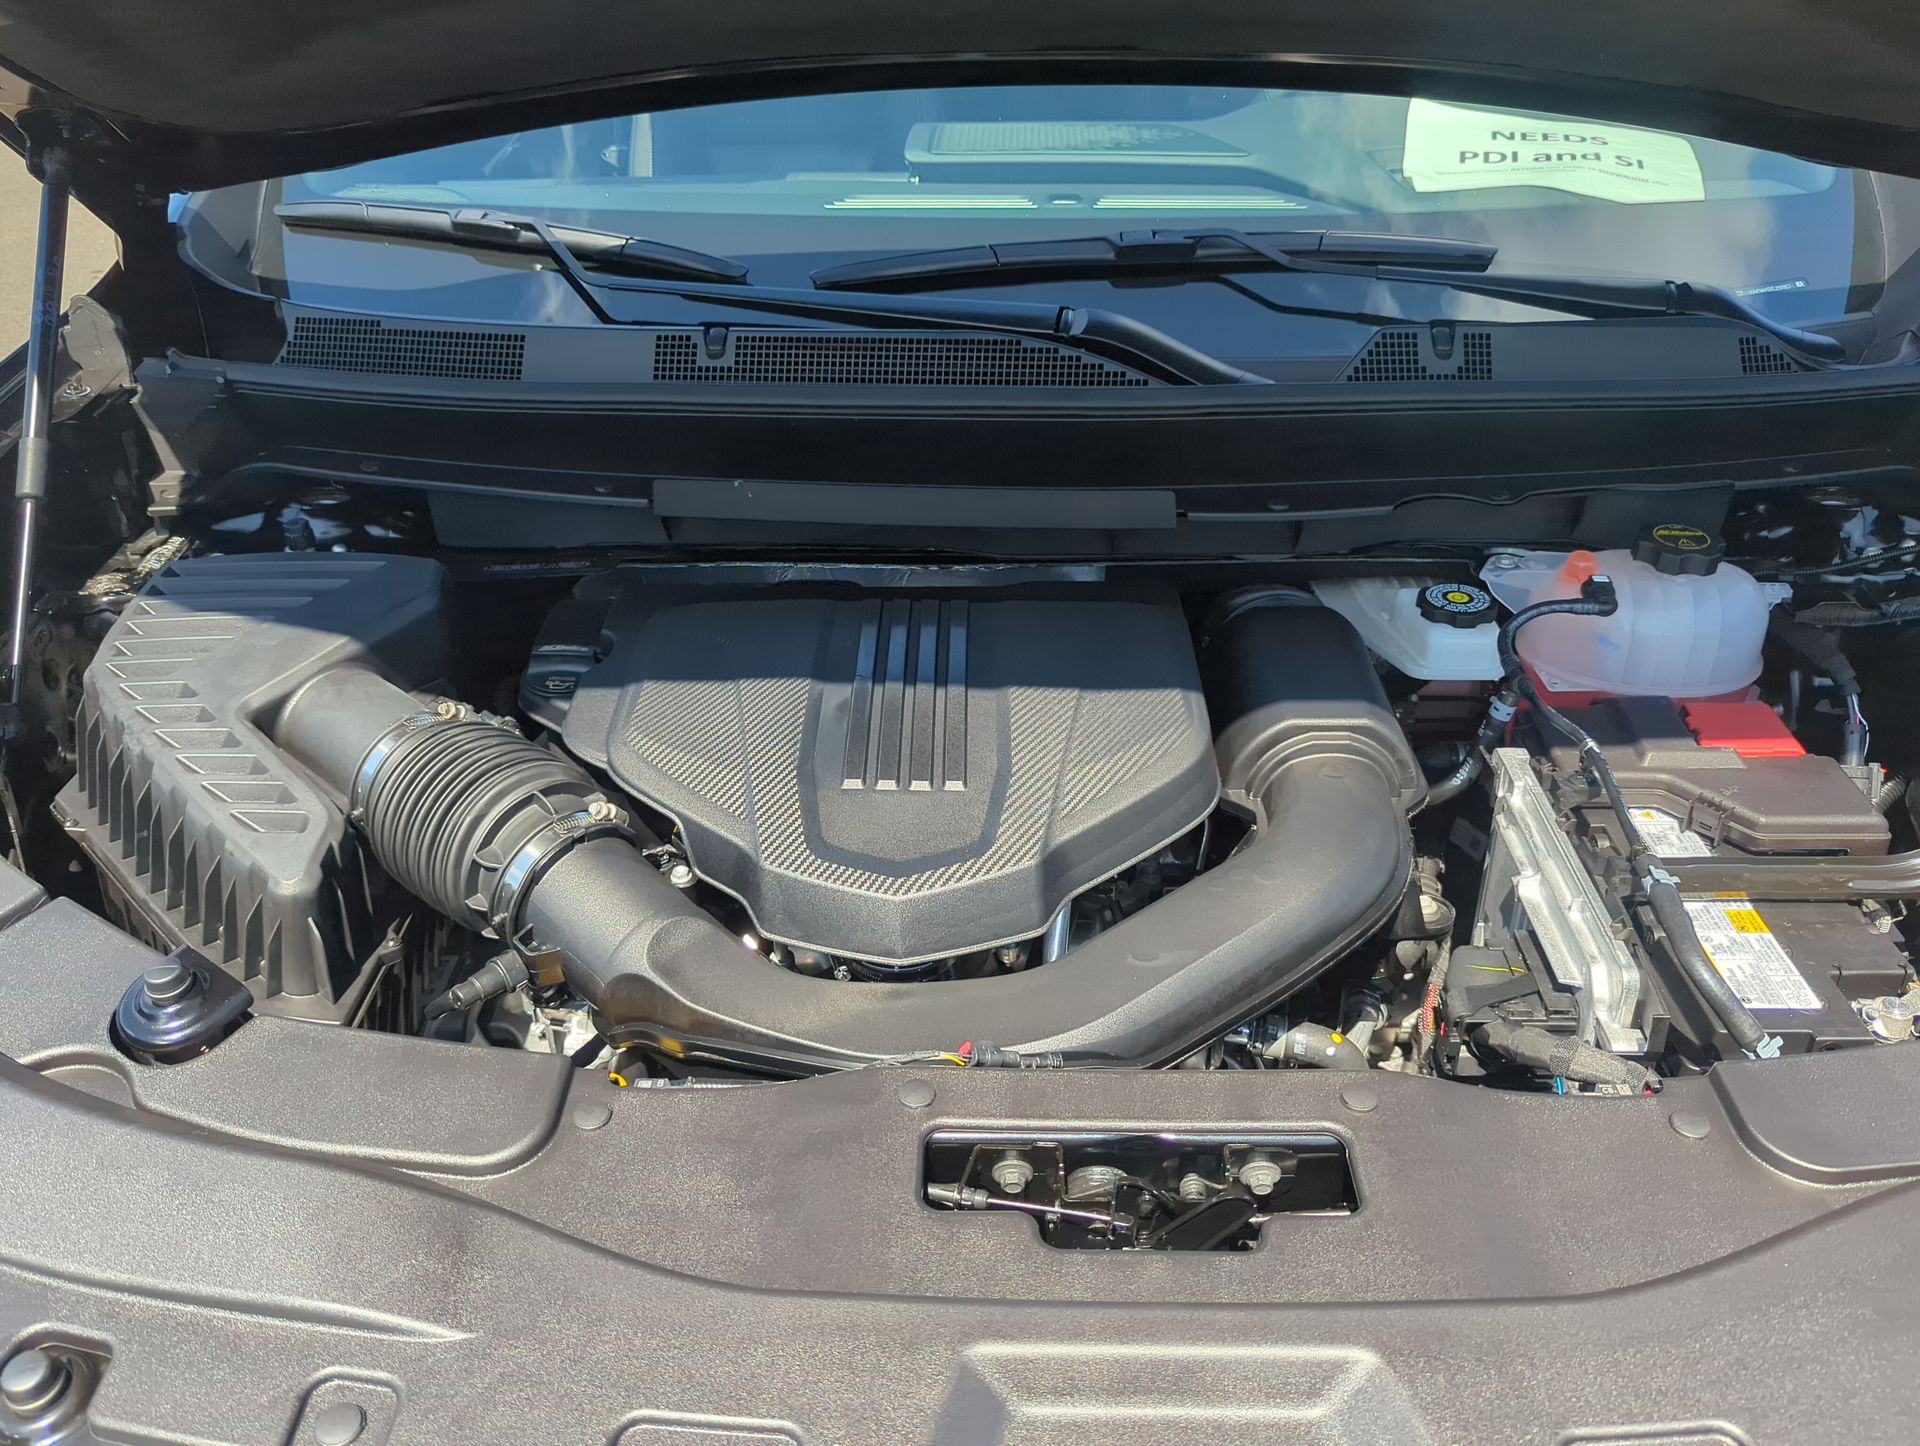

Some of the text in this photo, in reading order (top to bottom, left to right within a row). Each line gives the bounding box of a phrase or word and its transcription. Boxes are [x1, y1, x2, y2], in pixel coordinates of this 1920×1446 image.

[1490, 131, 1609, 146] NEEDS
[1458, 151, 1645, 170] PDI and SI
